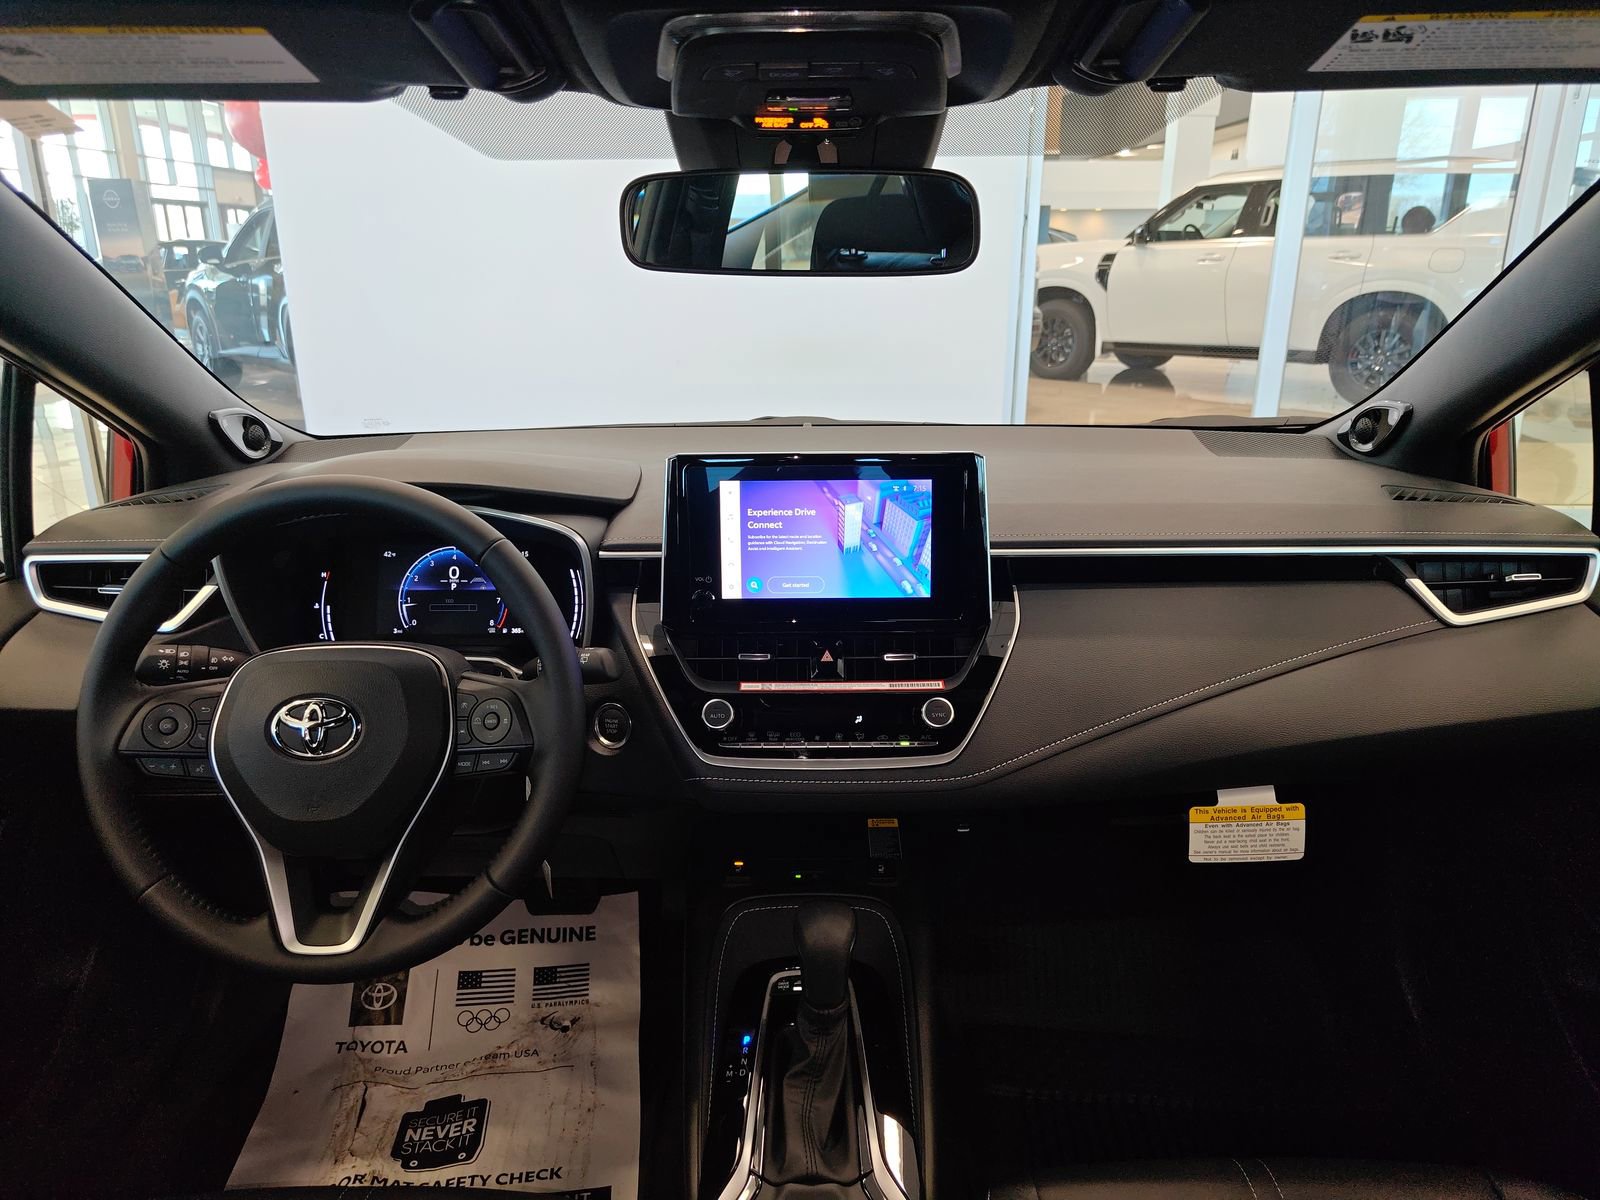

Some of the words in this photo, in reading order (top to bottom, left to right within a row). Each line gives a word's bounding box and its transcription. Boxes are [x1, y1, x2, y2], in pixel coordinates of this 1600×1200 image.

[748, 508, 793, 518] Experience
[794, 508, 816, 516] Drive
[748, 521, 783, 529] Connect
[449, 566, 460, 579] 0
[1250, 806, 1282, 814] Equipped
[470, 934, 495, 946] be
[500, 925, 596, 946] GENUINE
[335, 1040, 408, 1054] TOYOTA
[743, 1036, 750, 1045] P
[374, 1066, 411, 1076] Proud
[414, 1061, 460, 1074] Partner
[514, 1049, 540, 1058] USA
[409, 1110, 464, 1128] SECURE
[467, 1106, 480, 1118] IT
[404, 1118, 478, 1142] NEVER
[400, 1138, 456, 1155] STACK
[458, 1133, 474, 1147] IT
[331, 1174, 368, 1187] OR
[495, 1166, 563, 1186] CHECK
